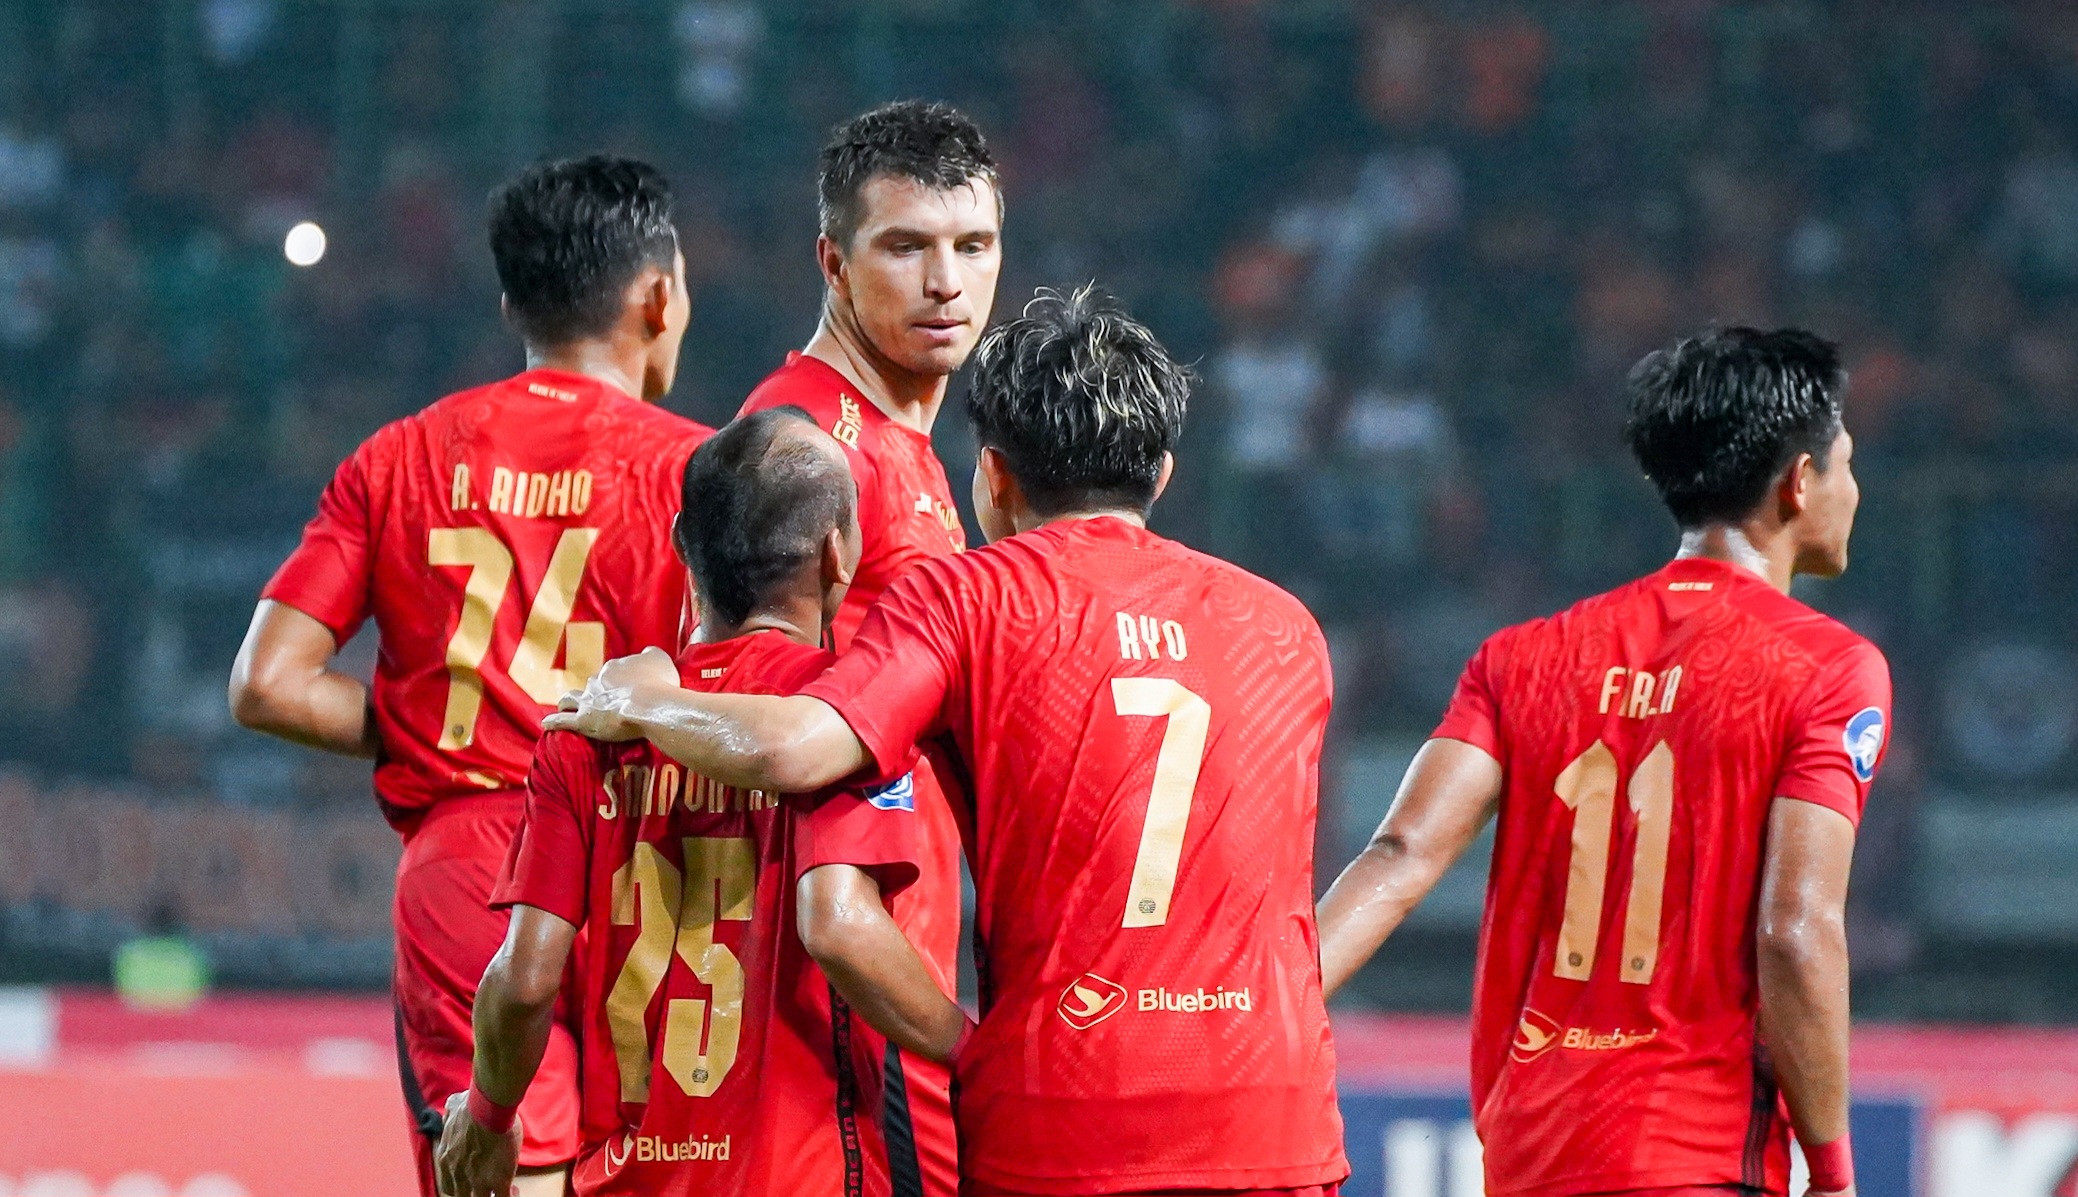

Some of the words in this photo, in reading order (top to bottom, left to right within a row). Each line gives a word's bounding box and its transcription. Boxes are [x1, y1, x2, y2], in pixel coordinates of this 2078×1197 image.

[452, 463, 478, 511] A.
[489, 466, 593, 518] RIDHO
[428, 527, 606, 750] 74
[1116, 611, 1188, 662] RYO
[1110, 677, 1212, 928] 7
[1554, 738, 1675, 985] 11
[605, 836, 757, 1104] 25
[1138, 986, 1253, 1013] Bluebird
[636, 1133, 731, 1162] Bluebird
